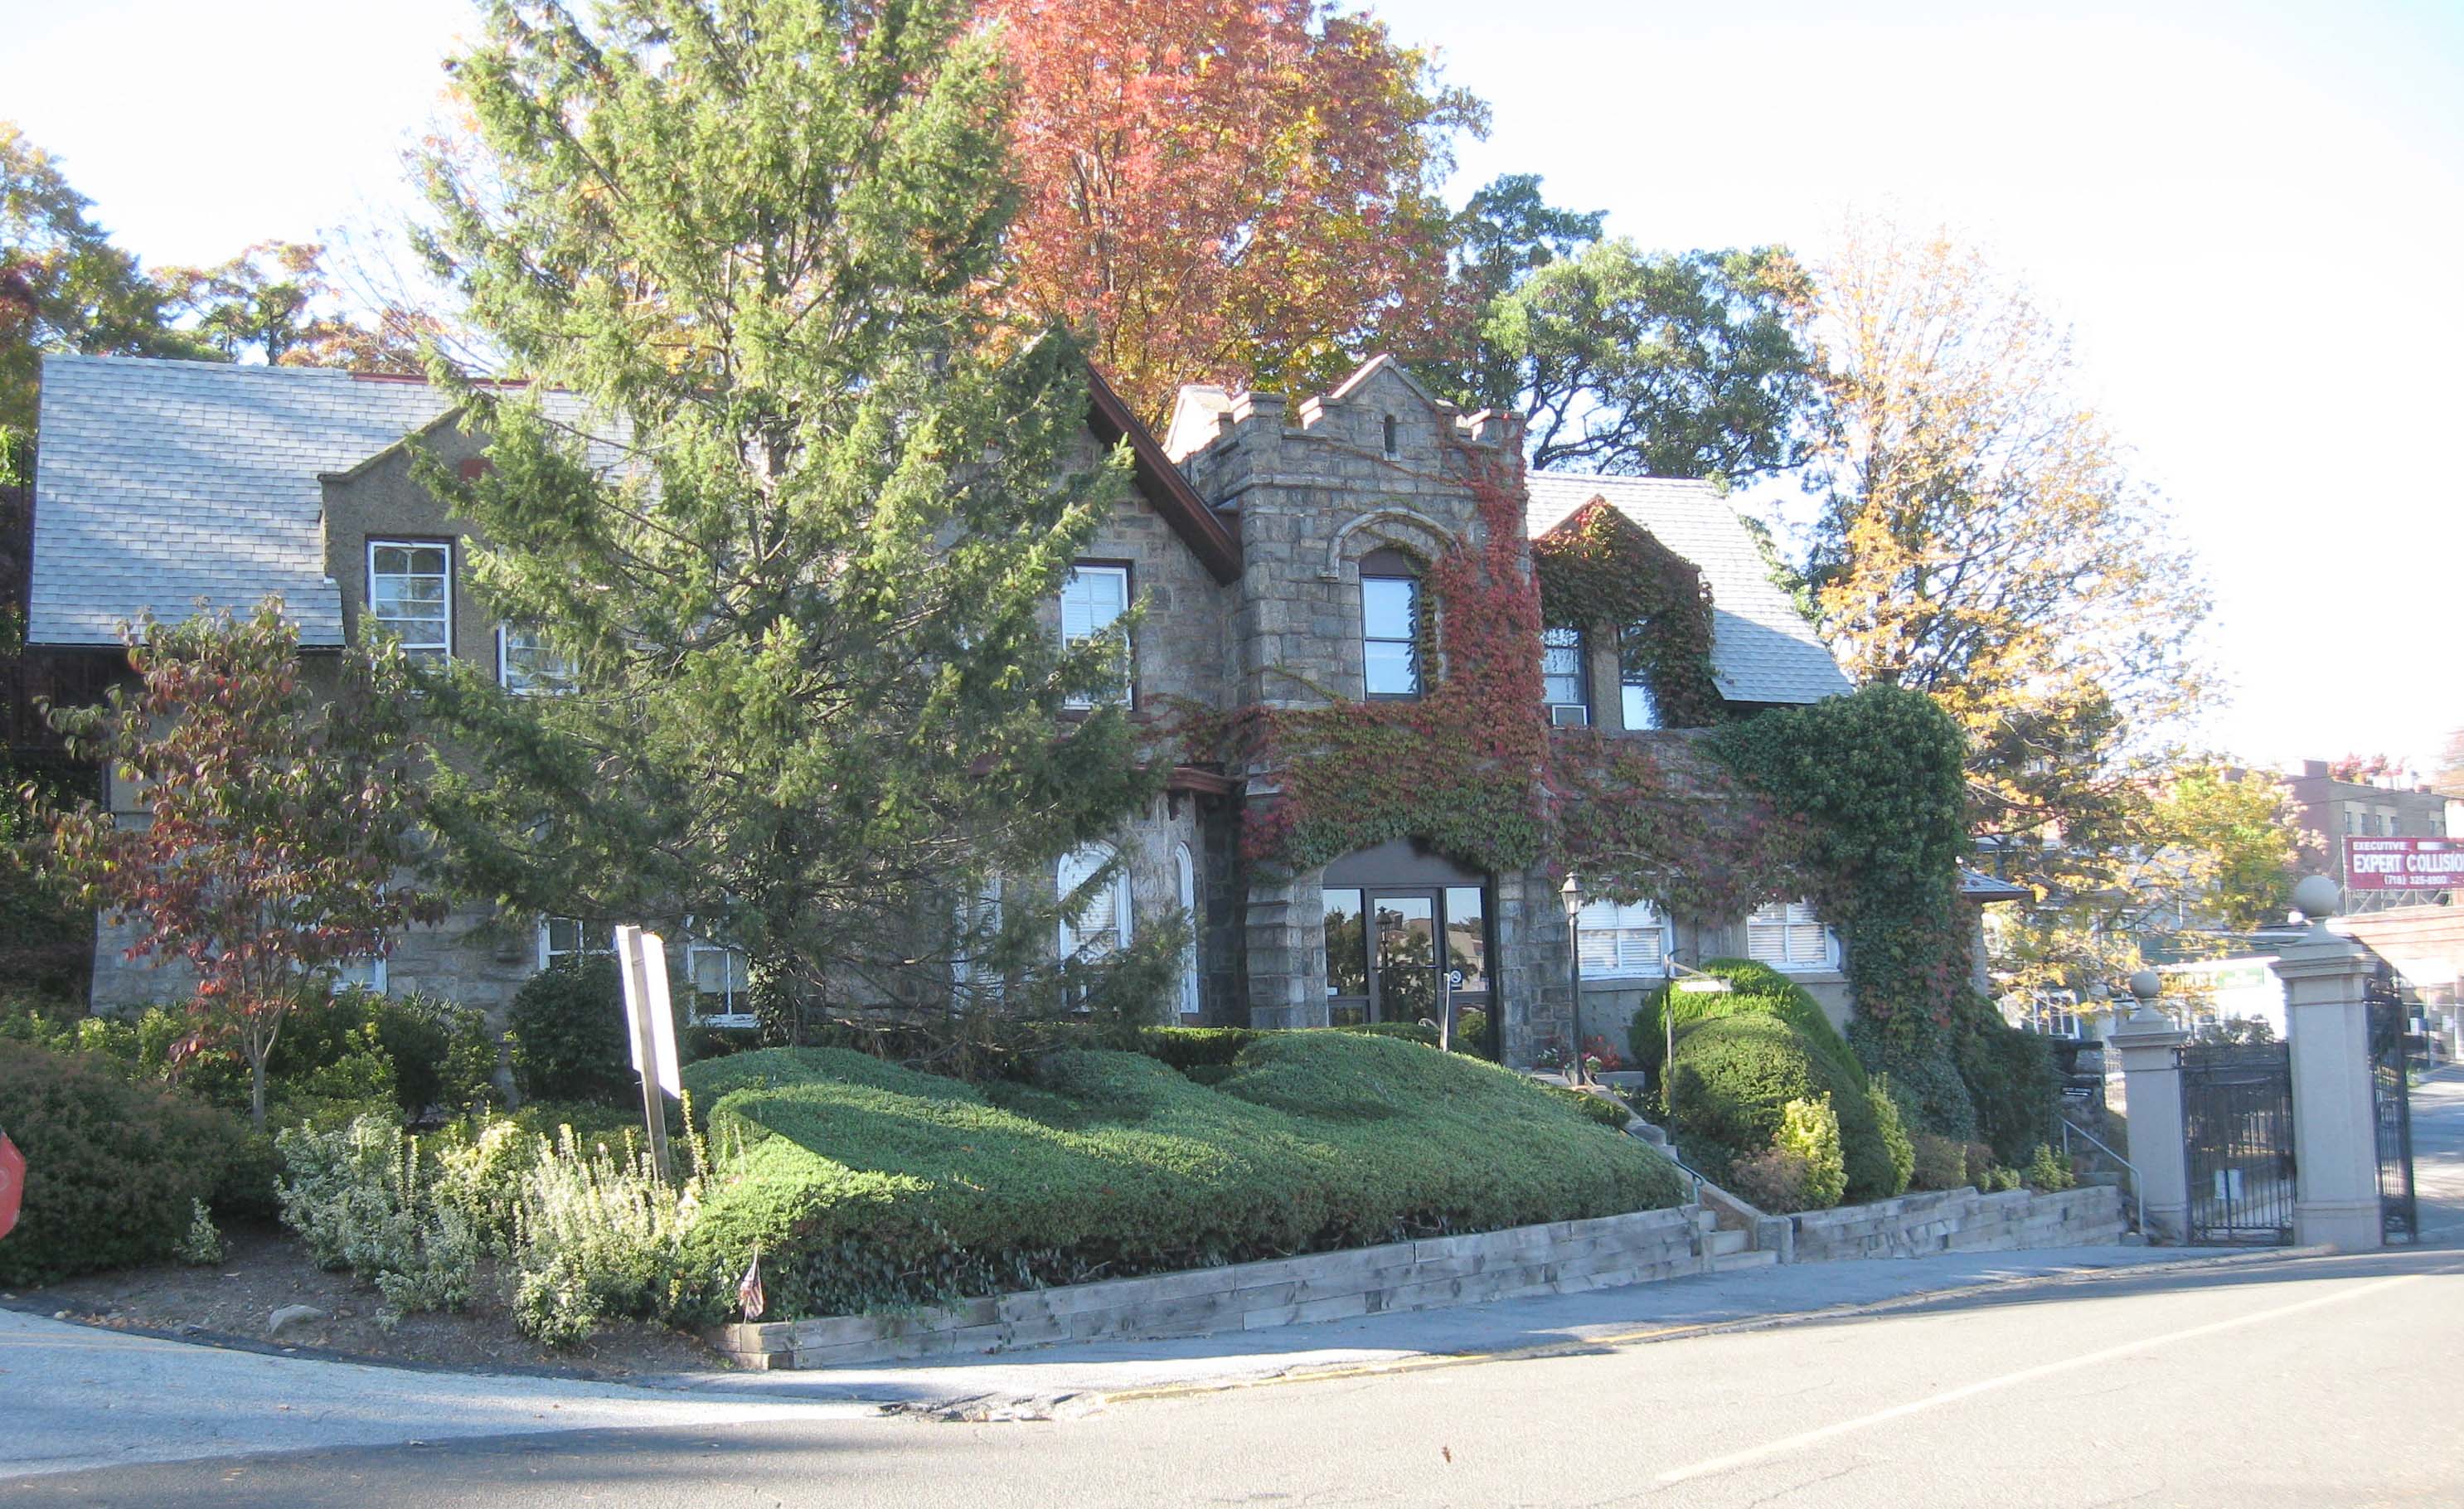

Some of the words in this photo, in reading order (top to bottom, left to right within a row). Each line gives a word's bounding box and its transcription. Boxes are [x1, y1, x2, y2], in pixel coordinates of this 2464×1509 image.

[2353, 842, 2407, 851] EXECUTIVE
[2353, 854, 2402, 873] EXPERT
[2406, 854, 2464, 872] COLLISIO
